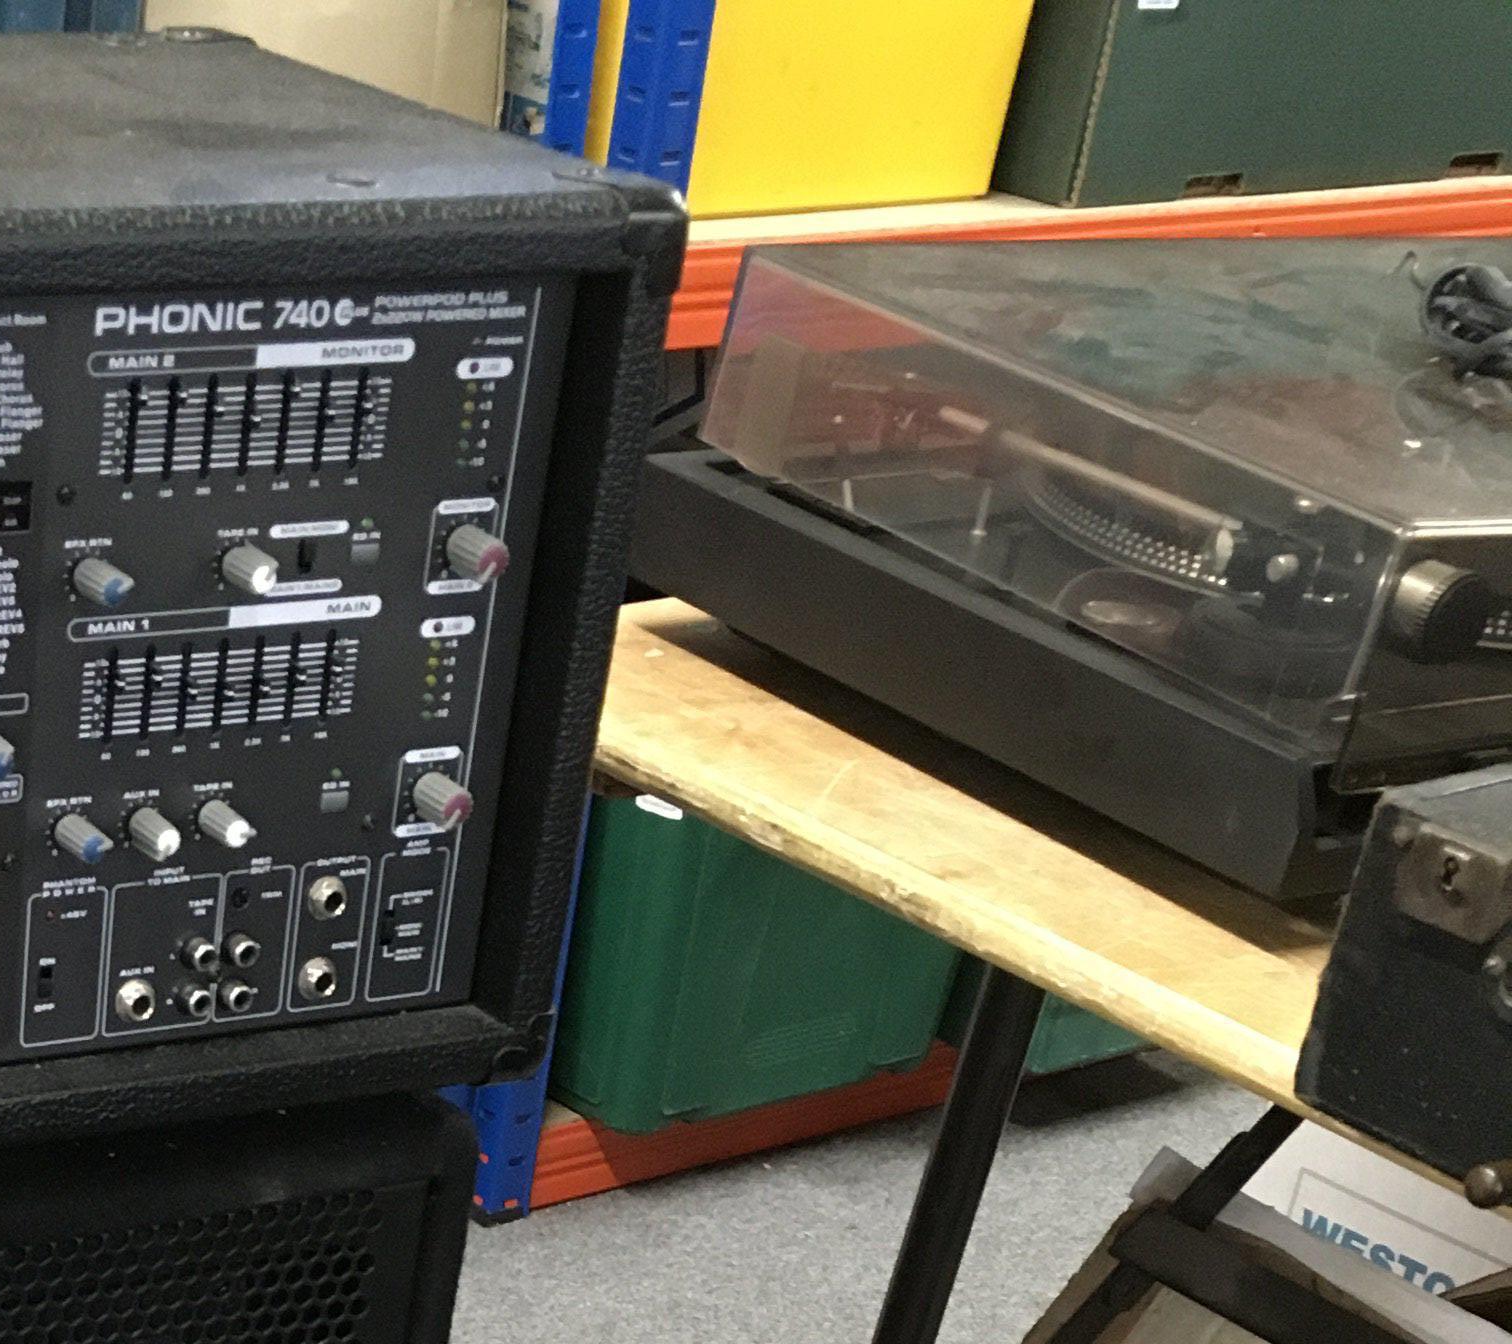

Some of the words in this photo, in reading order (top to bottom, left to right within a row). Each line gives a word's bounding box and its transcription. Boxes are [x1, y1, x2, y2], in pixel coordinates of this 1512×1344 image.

[94, 301, 263, 336] PHONIC
[273, 299, 330, 328] 740
[322, 344, 404, 358] MONITOR
[109, 355, 159, 369] MAIN
[327, 601, 371, 614] MAIN
[88, 620, 135, 635] MAIN
[141, 619, 150, 631] 1
[1303, 1208, 1455, 1293] WESTO
